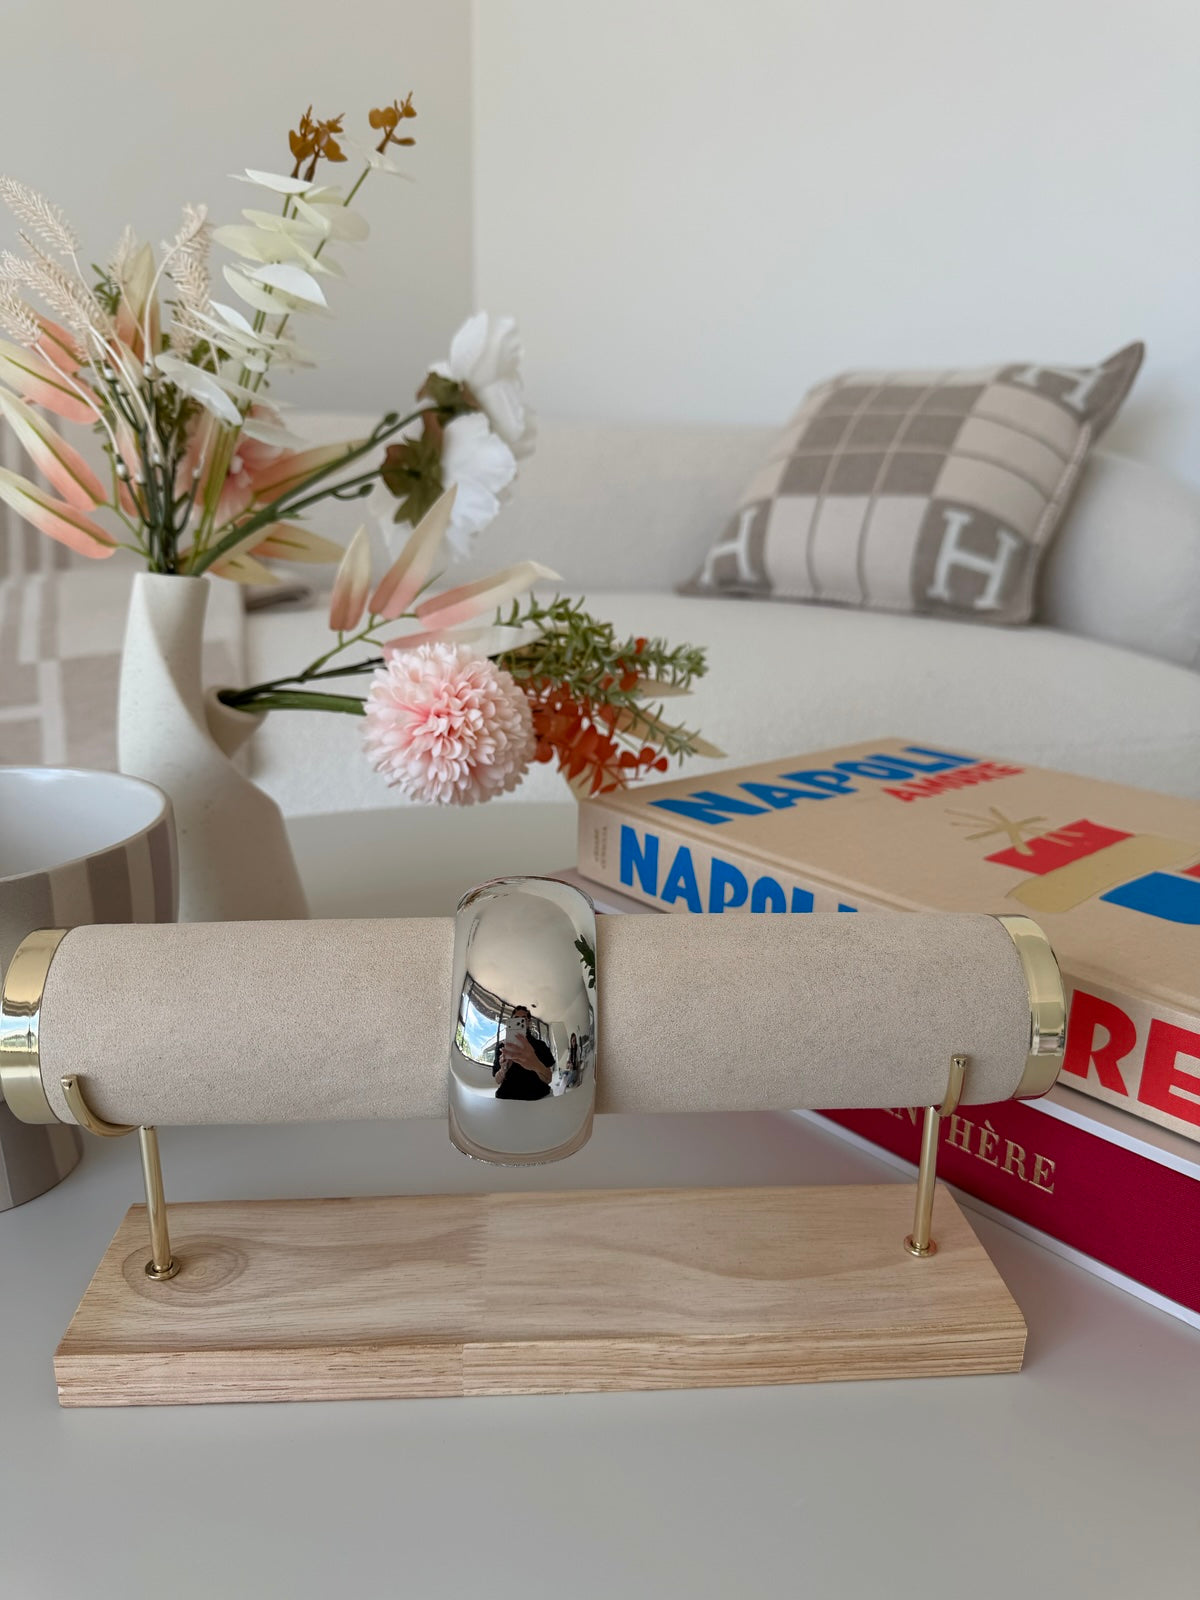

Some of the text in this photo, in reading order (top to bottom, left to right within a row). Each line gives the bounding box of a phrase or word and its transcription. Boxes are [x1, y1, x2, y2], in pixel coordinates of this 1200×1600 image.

[927, 508, 1018, 610] H
[648, 746, 983, 825] NAPOLI
[619, 824, 858, 913] NAPO
